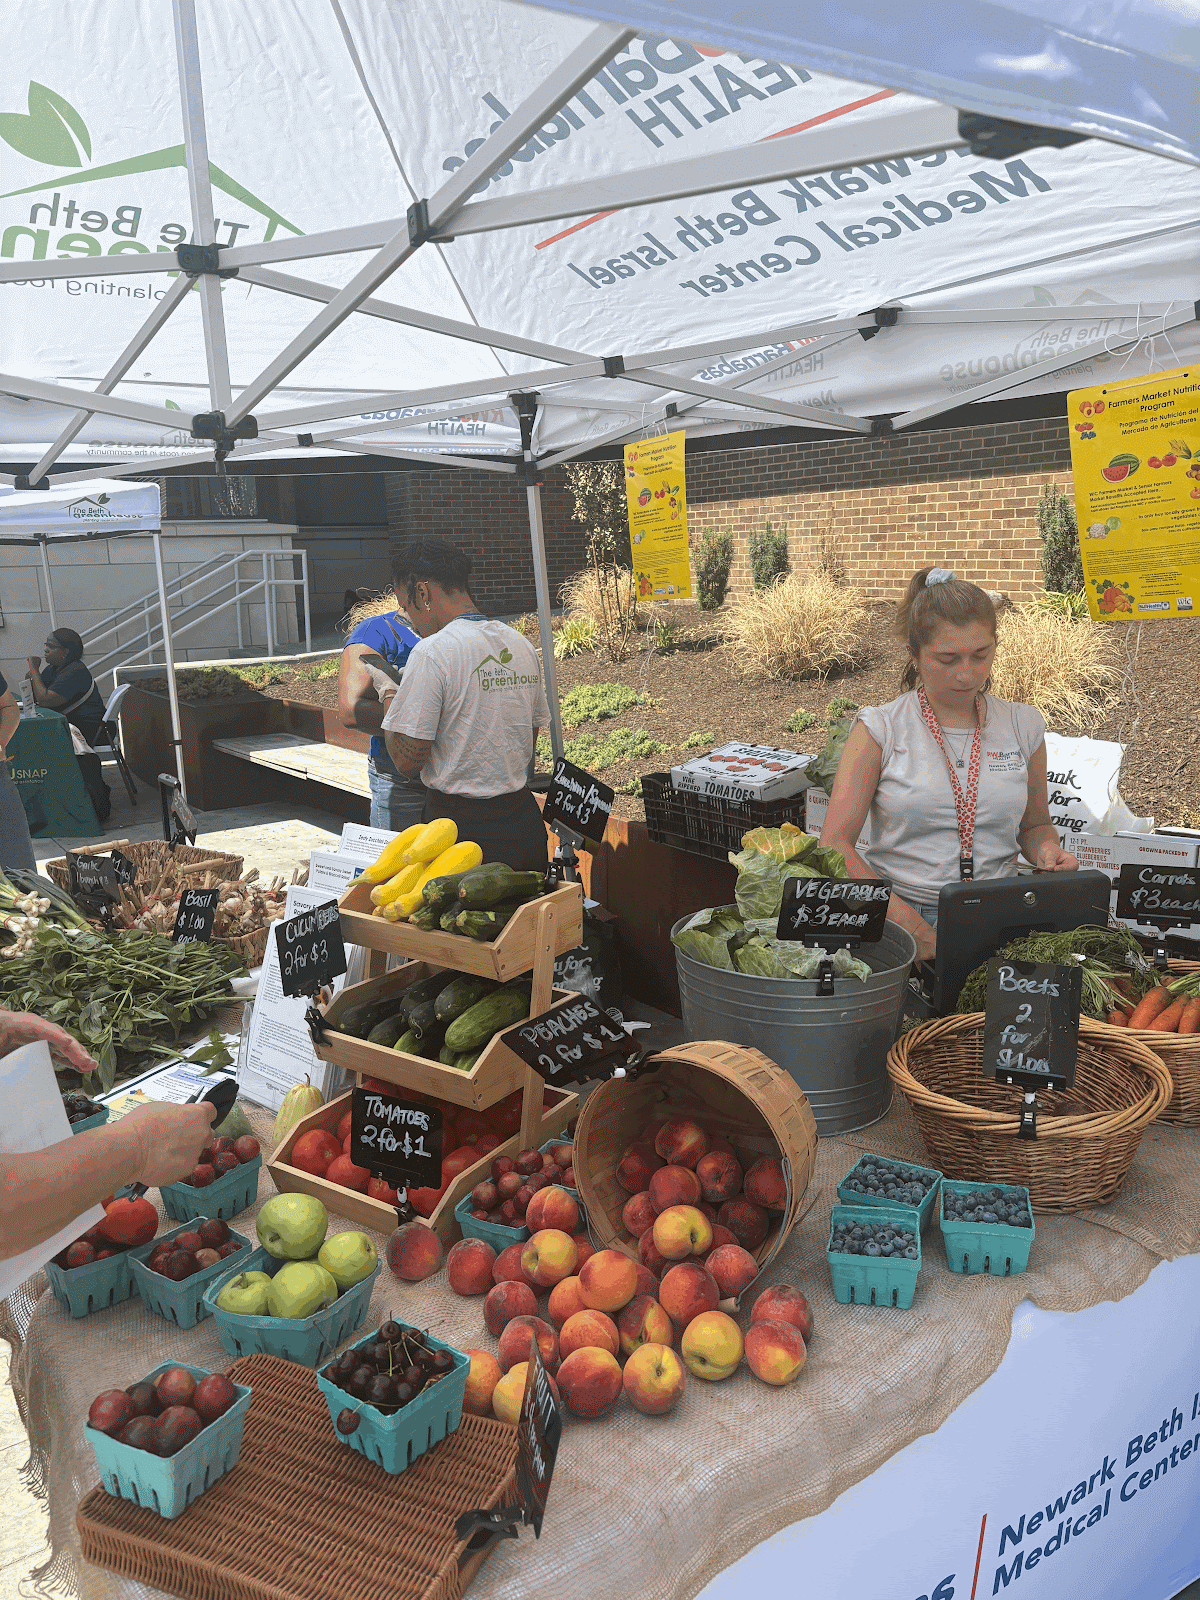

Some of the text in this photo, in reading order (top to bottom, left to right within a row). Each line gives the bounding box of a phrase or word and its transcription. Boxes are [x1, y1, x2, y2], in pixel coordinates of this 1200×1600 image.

[1108, 397, 1140, 408] Farmers
[1142, 390, 1171, 402] Market
[1140, 400, 1175, 412] Program
[1120, 418, 1148, 428] Programa
[11, 768, 48, 780] JSNAP
[682, 776, 696, 784] VINE
[1046, 769, 1082, 789] ank
[704, 782, 755, 800] TOMATOES
[1048, 790, 1082, 806] for
[554, 790, 564, 806] 2
[562, 794, 576, 814] for
[1076, 846, 1111, 855] STRAWBERRIES
[1076, 853, 1107, 862] BLUEBERRIES
[1096, 862, 1120, 870] TOMATOES
[1138, 868, 1196, 886] Carrots
[185, 890, 212, 908] Basil
[796, 878, 891, 904] VEGETABLES
[1130, 887, 1200, 911] $3 each
[293, 900, 312, 910] Savory
[790, 904, 870, 929] $3 EACH
[284, 939, 329, 976] 2 for $3
[998, 966, 1060, 997] Beets
[1015, 1003, 1033, 1024] 2
[518, 1001, 600, 1048] PEACHES
[1000, 1024, 1032, 1046] for
[538, 1054, 564, 1074] 2
[364, 1096, 430, 1132] TOMATOES
[360, 1124, 432, 1160] 2 for $1
[532, 1355, 556, 1431] FRUIT
[998, 1406, 1183, 1557] Newark Beth
[992, 1432, 1200, 1596] Medical Center
